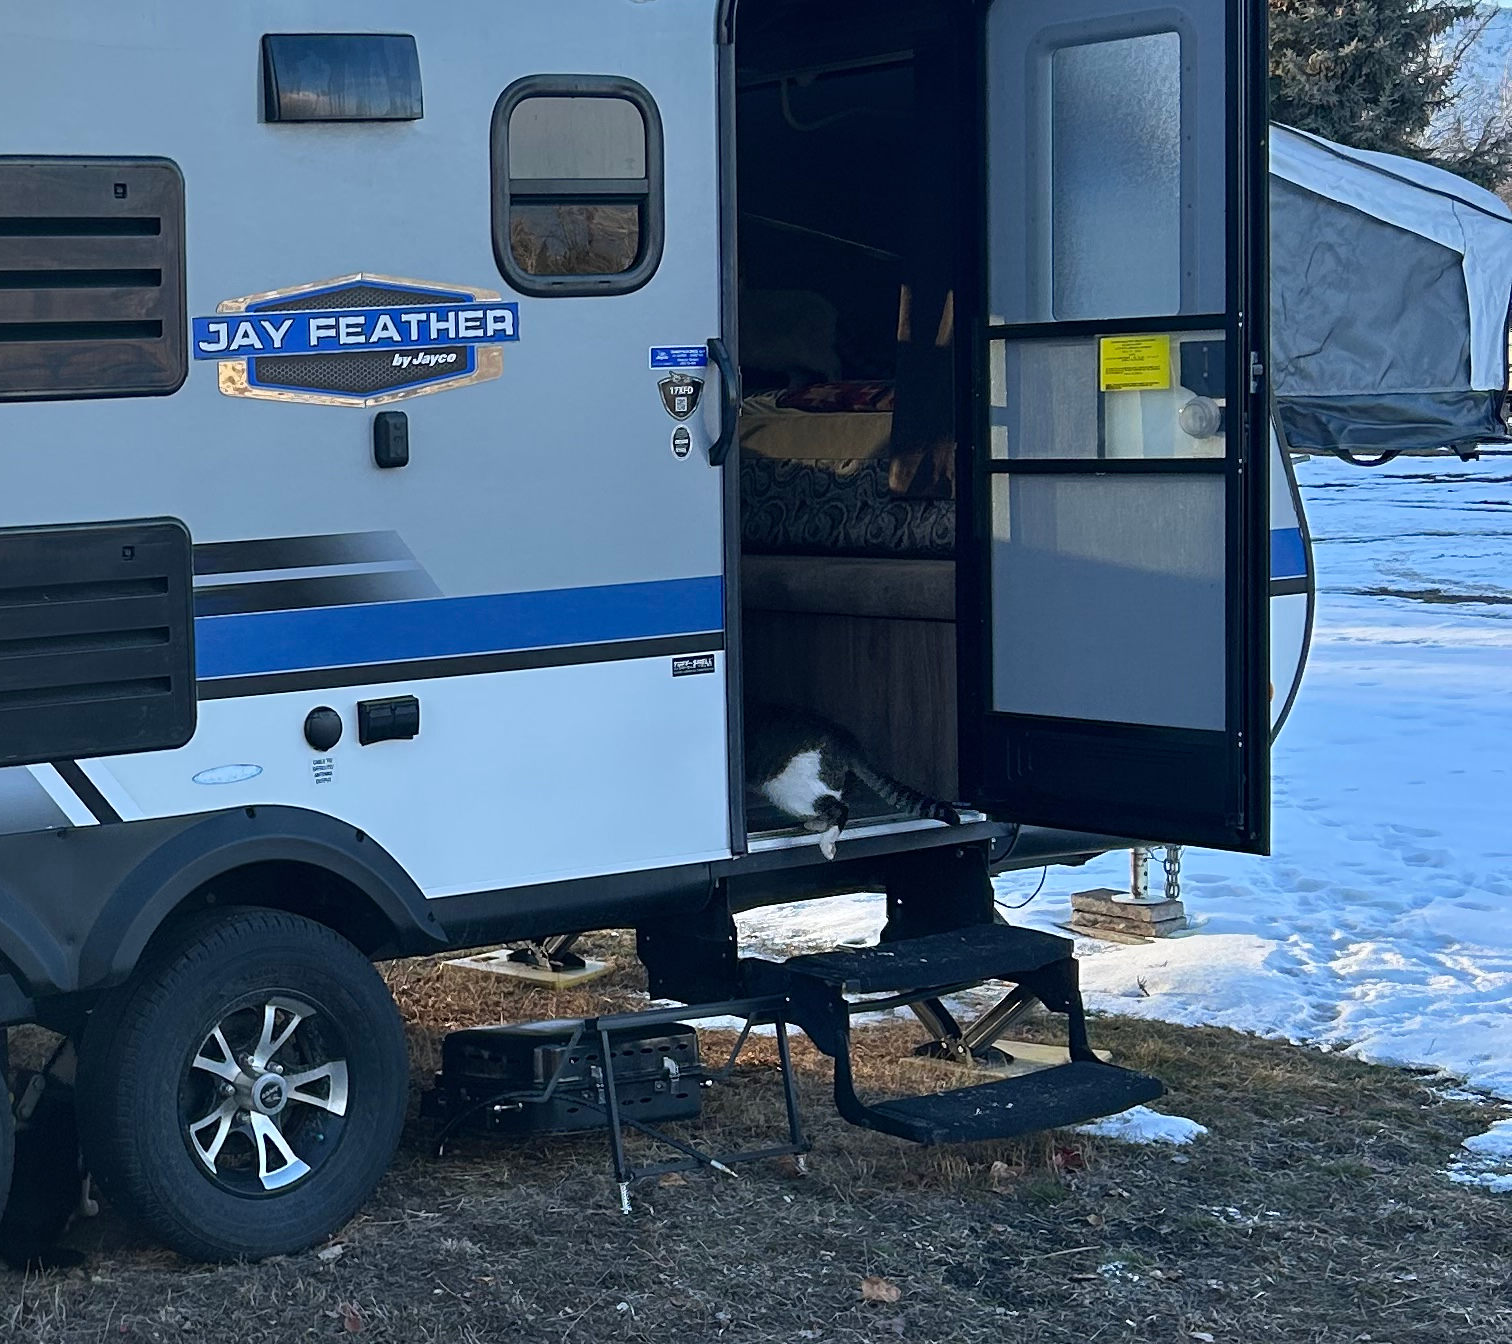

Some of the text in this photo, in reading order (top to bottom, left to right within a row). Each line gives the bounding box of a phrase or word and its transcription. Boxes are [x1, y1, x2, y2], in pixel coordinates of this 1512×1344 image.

[198, 308, 515, 353] JAY FEATHER
[392, 351, 457, 368] by Jayco
